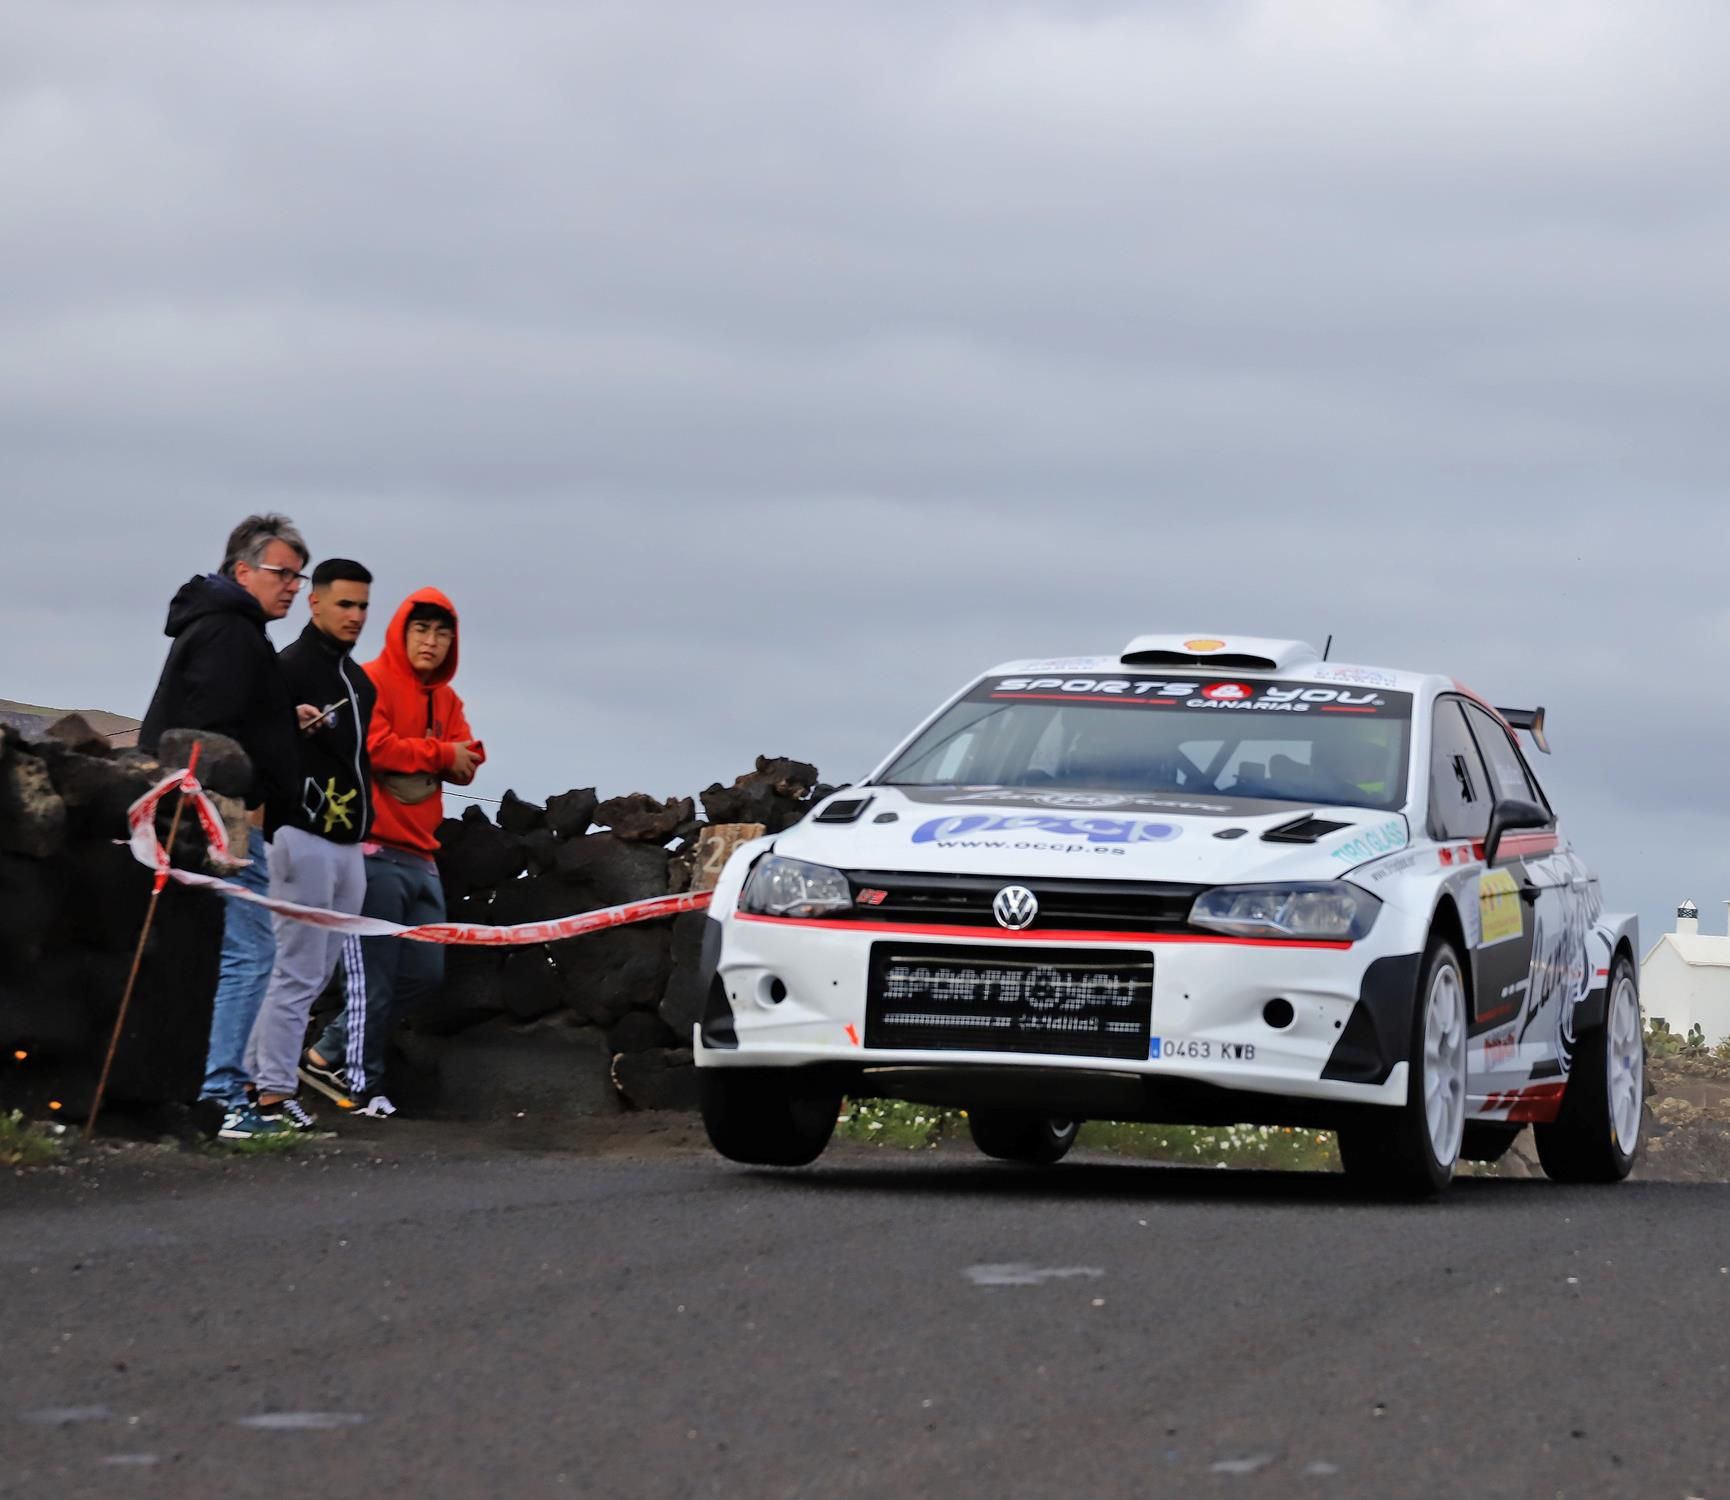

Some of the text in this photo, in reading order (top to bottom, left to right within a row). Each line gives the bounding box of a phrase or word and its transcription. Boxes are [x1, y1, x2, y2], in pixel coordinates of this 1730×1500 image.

[994, 677, 1200, 697] SPORTS
[1210, 682, 1245, 700] &
[1185, 698, 1311, 713] CANARIAS
[936, 839, 1127, 856] www.occp.es
[1163, 1039, 1211, 1059] 0463
[1220, 1042, 1256, 1061] KWB
